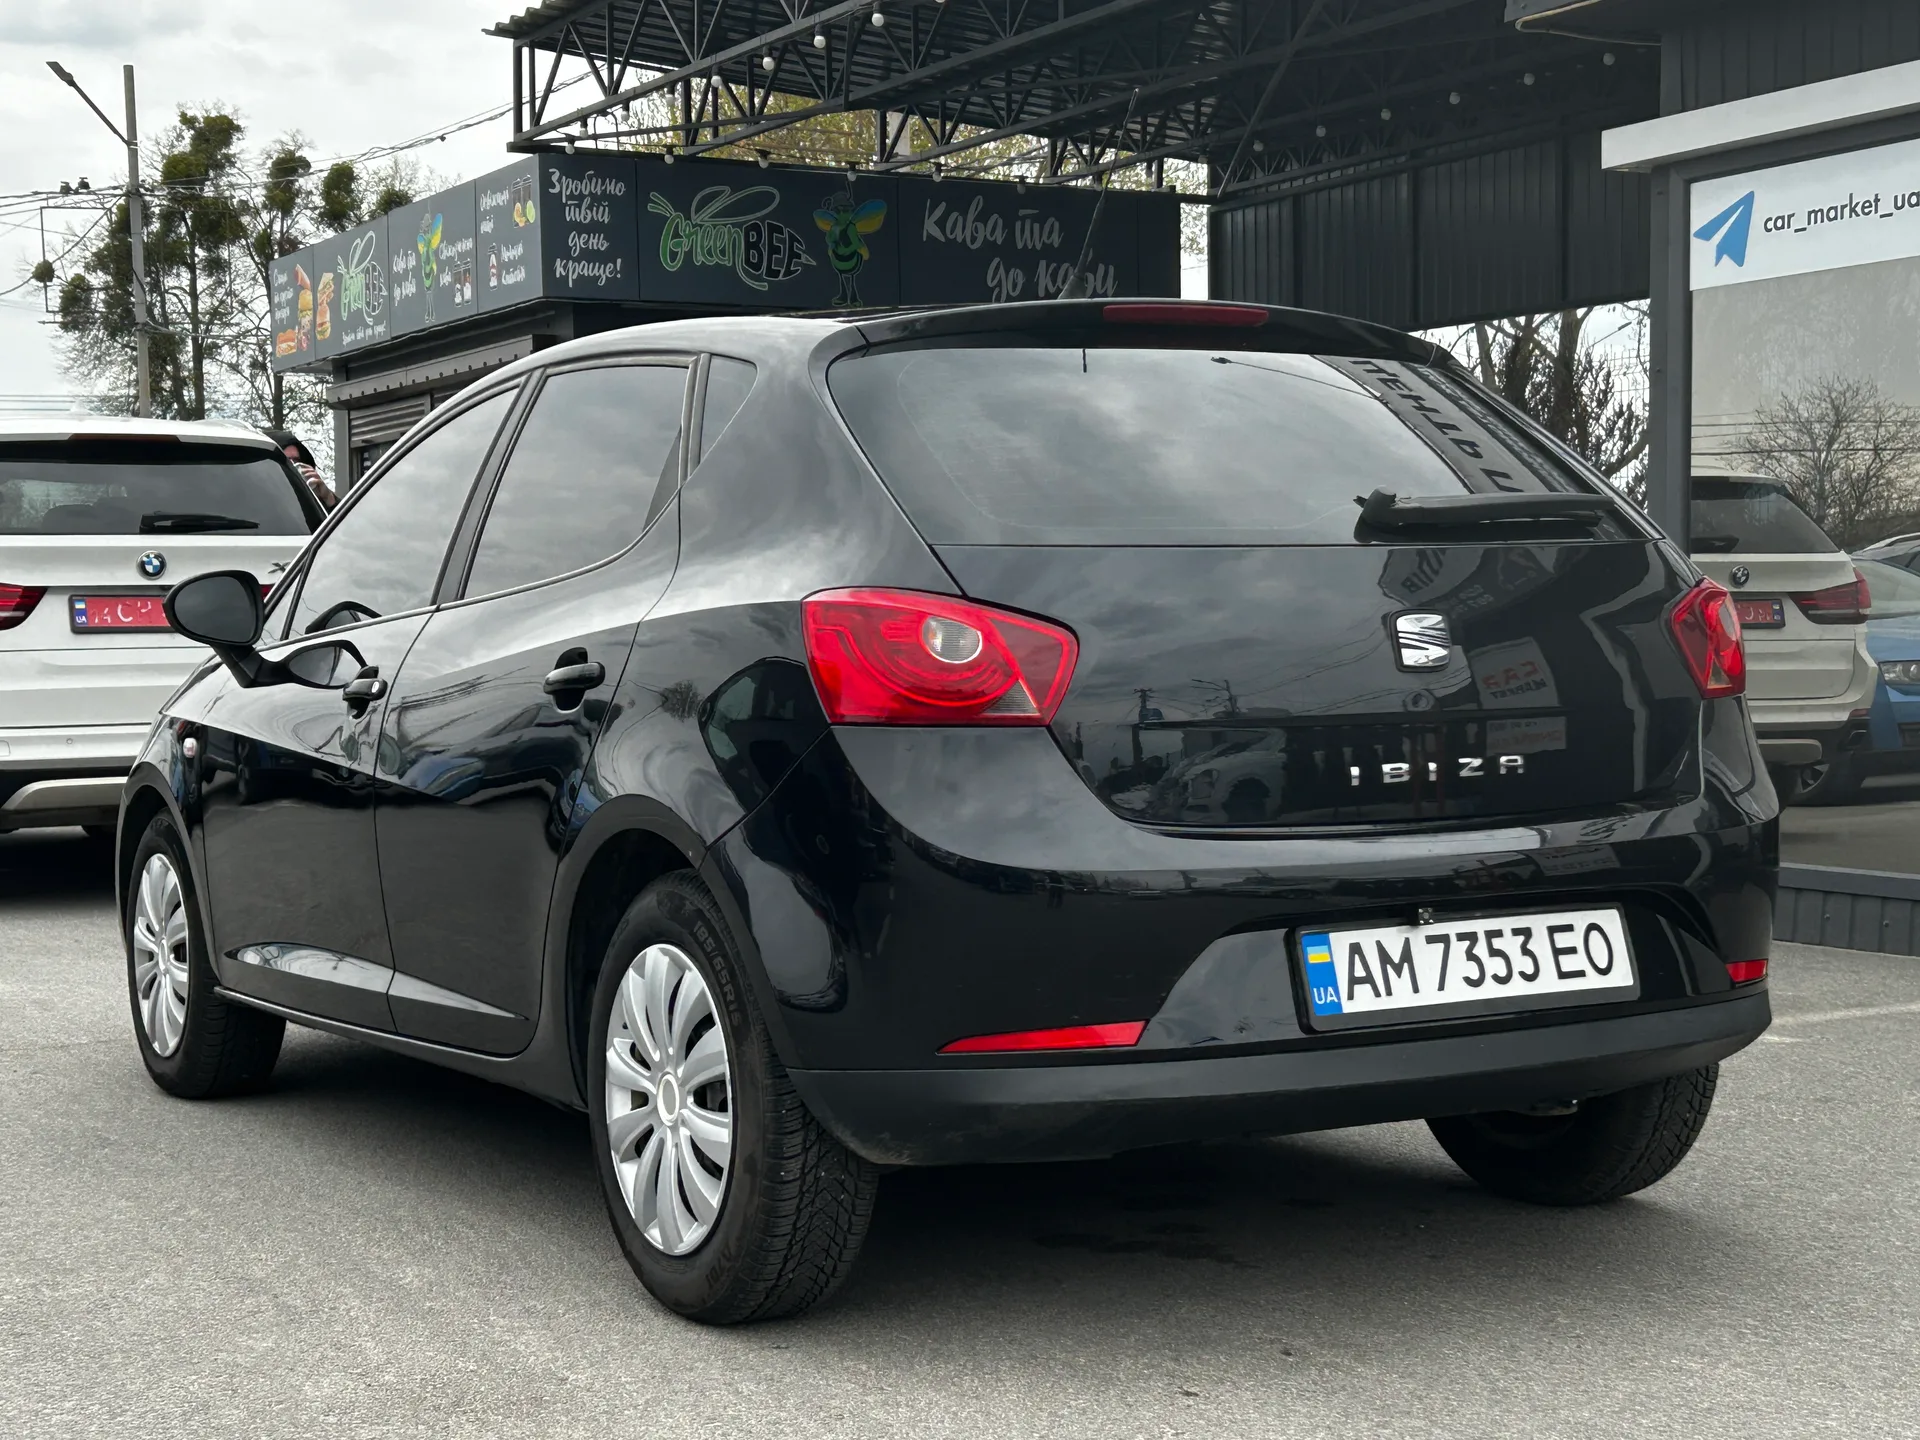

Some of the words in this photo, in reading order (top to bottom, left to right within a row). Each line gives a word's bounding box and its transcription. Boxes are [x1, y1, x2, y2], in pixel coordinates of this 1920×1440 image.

[549, 168, 626, 202] Зробимо
[565, 199, 610, 224] твій
[923, 195, 1007, 250] Кава
[1014, 209, 1063, 250] та
[1764, 191, 1920, 232] car_market_ua
[568, 231, 609, 257] день
[554, 259, 622, 287] краще!
[986, 257, 1025, 303] до
[1350, 756, 1525, 786] IBIZA
[1313, 986, 1340, 1005] UA
